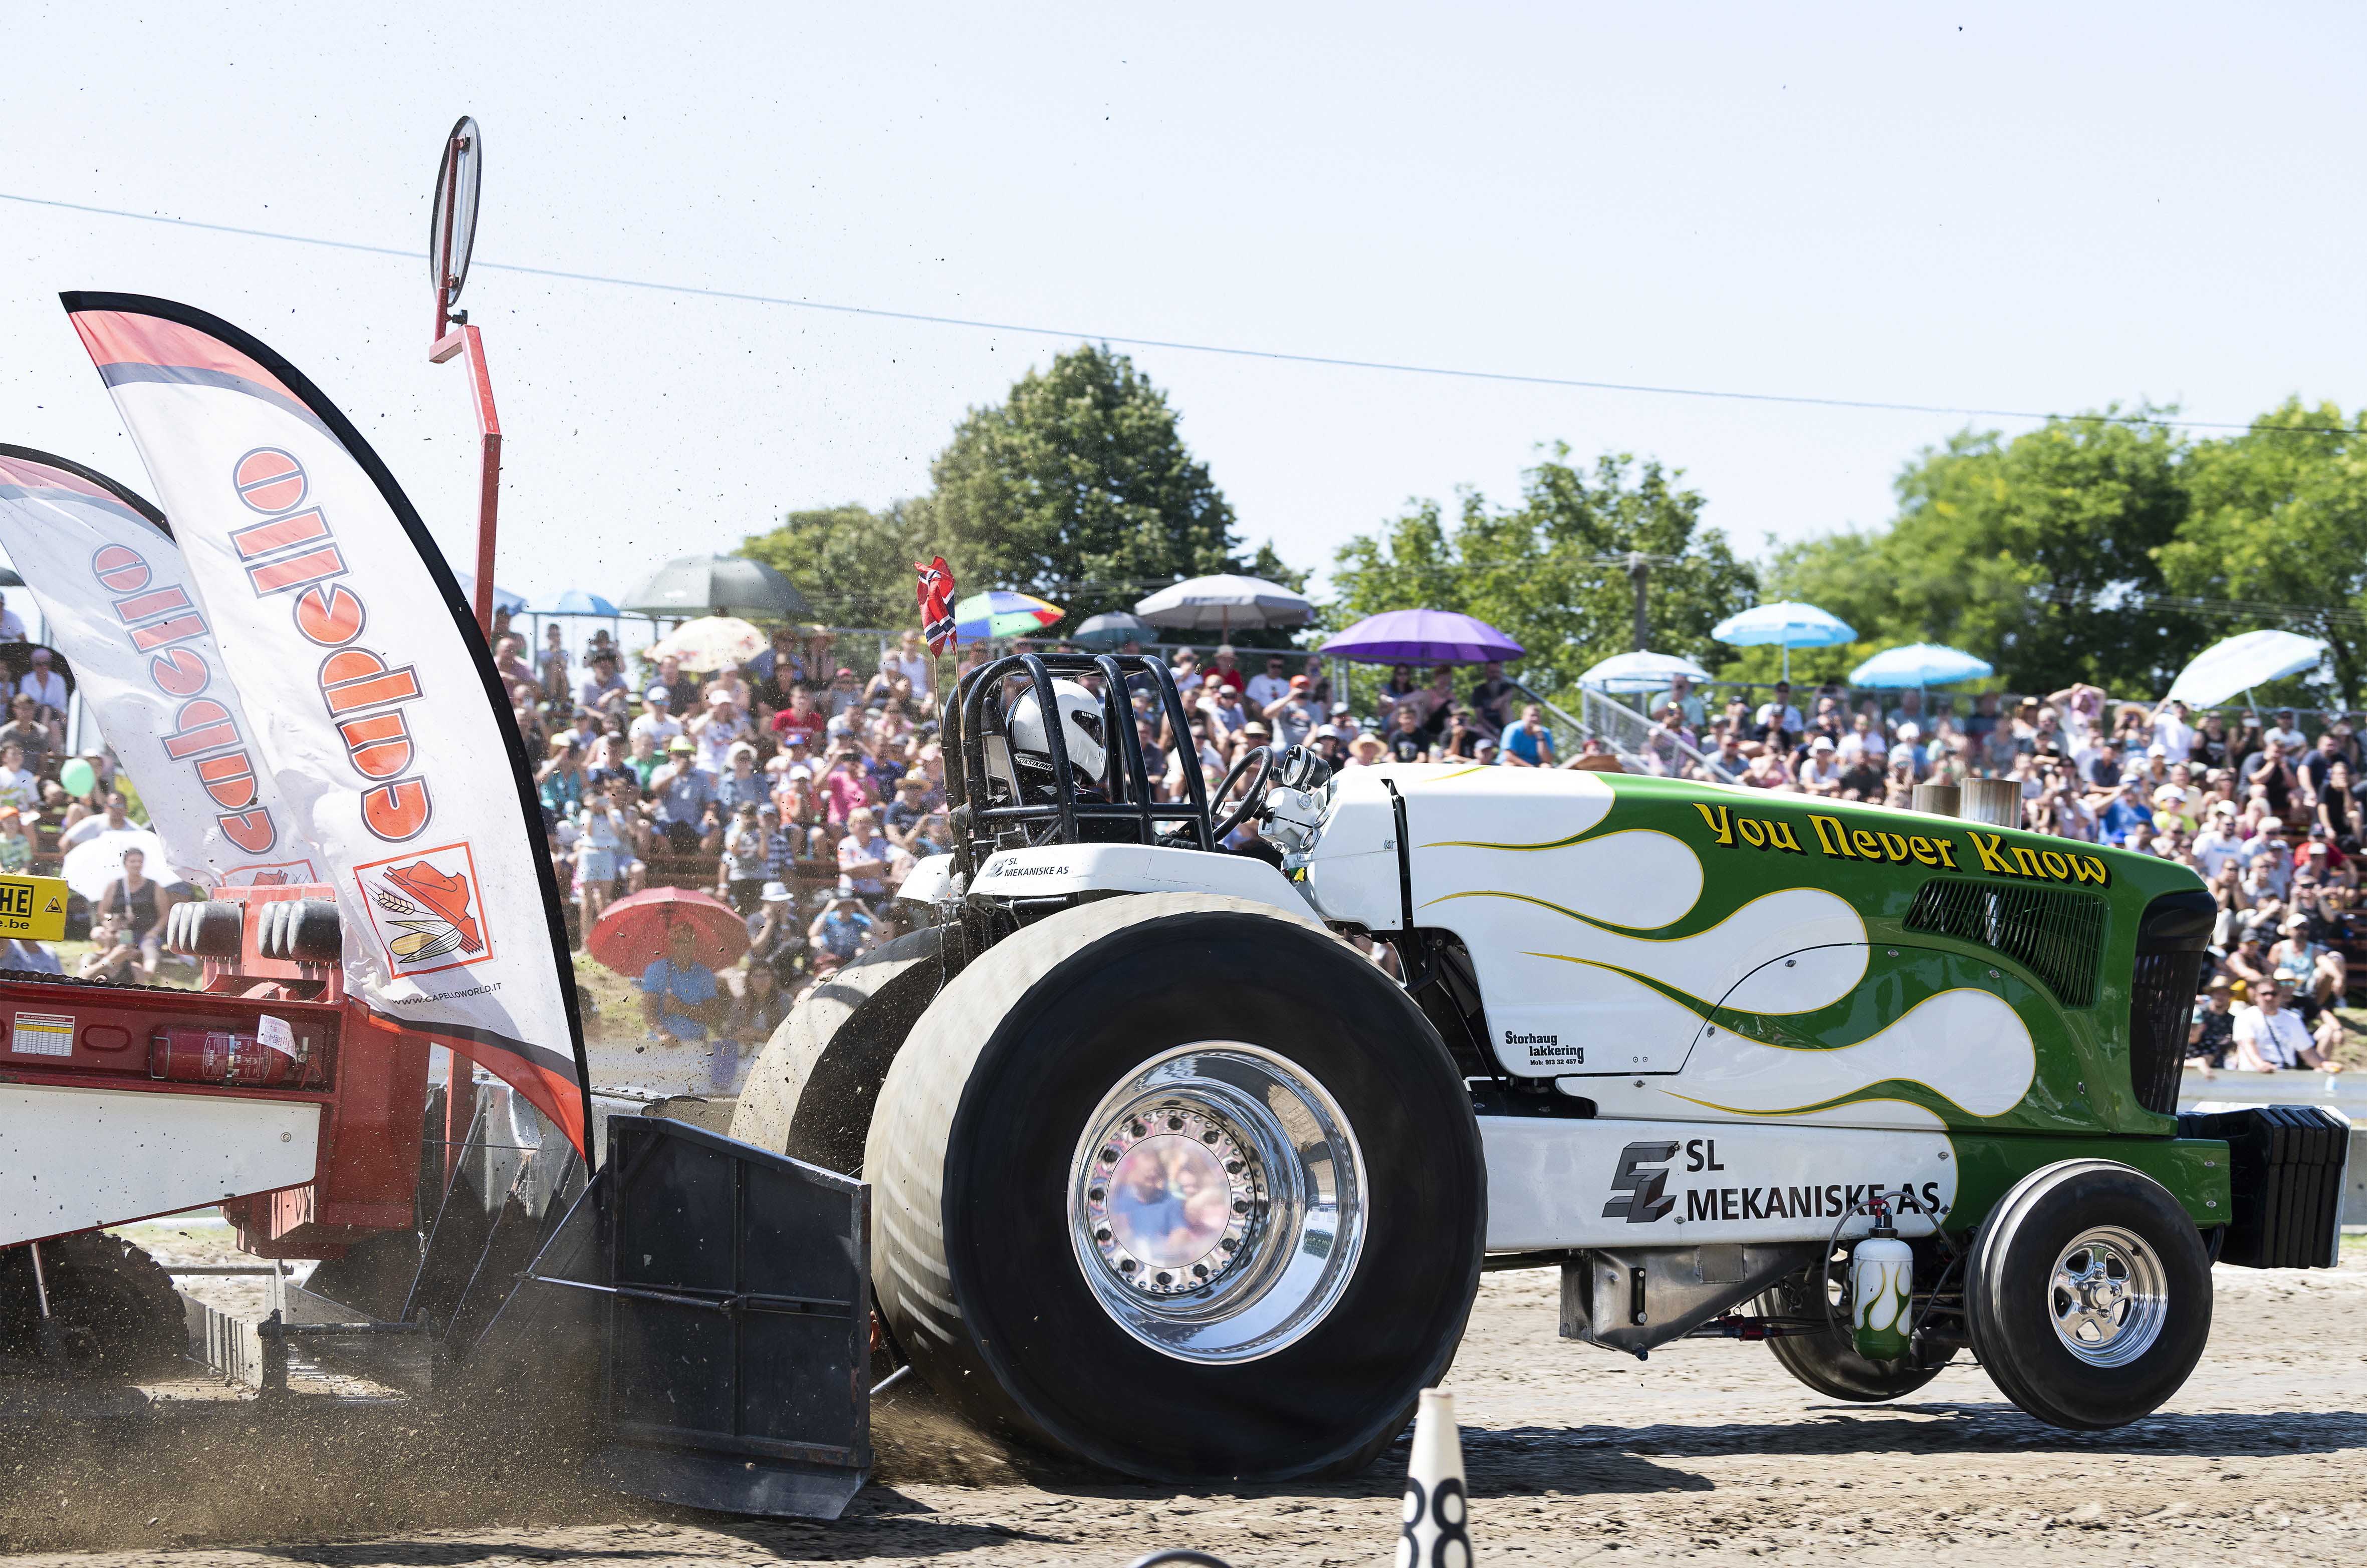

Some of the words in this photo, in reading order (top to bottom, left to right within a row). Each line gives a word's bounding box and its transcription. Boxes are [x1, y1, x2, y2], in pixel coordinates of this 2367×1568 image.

[228, 447, 434, 843] capello
[1082, 711, 1095, 719] BANDIT
[1691, 802, 1808, 856] You
[1807, 814, 1963, 873] Never
[1965, 830, 2111, 889] Know
[1004, 867, 1055, 877] MEKANISKE
[1056, 866, 1069, 874] AS
[392, 982, 502, 1005] WWW.CAPELLOWORLD.IT
[1505, 1030, 1558, 1046] Storhaug
[1529, 1045, 1584, 1064] lakkering
[1686, 1139, 1725, 1172] SL
[1687, 1184, 1885, 1222] MEKANISKE
[1897, 1182, 1941, 1216] AS
